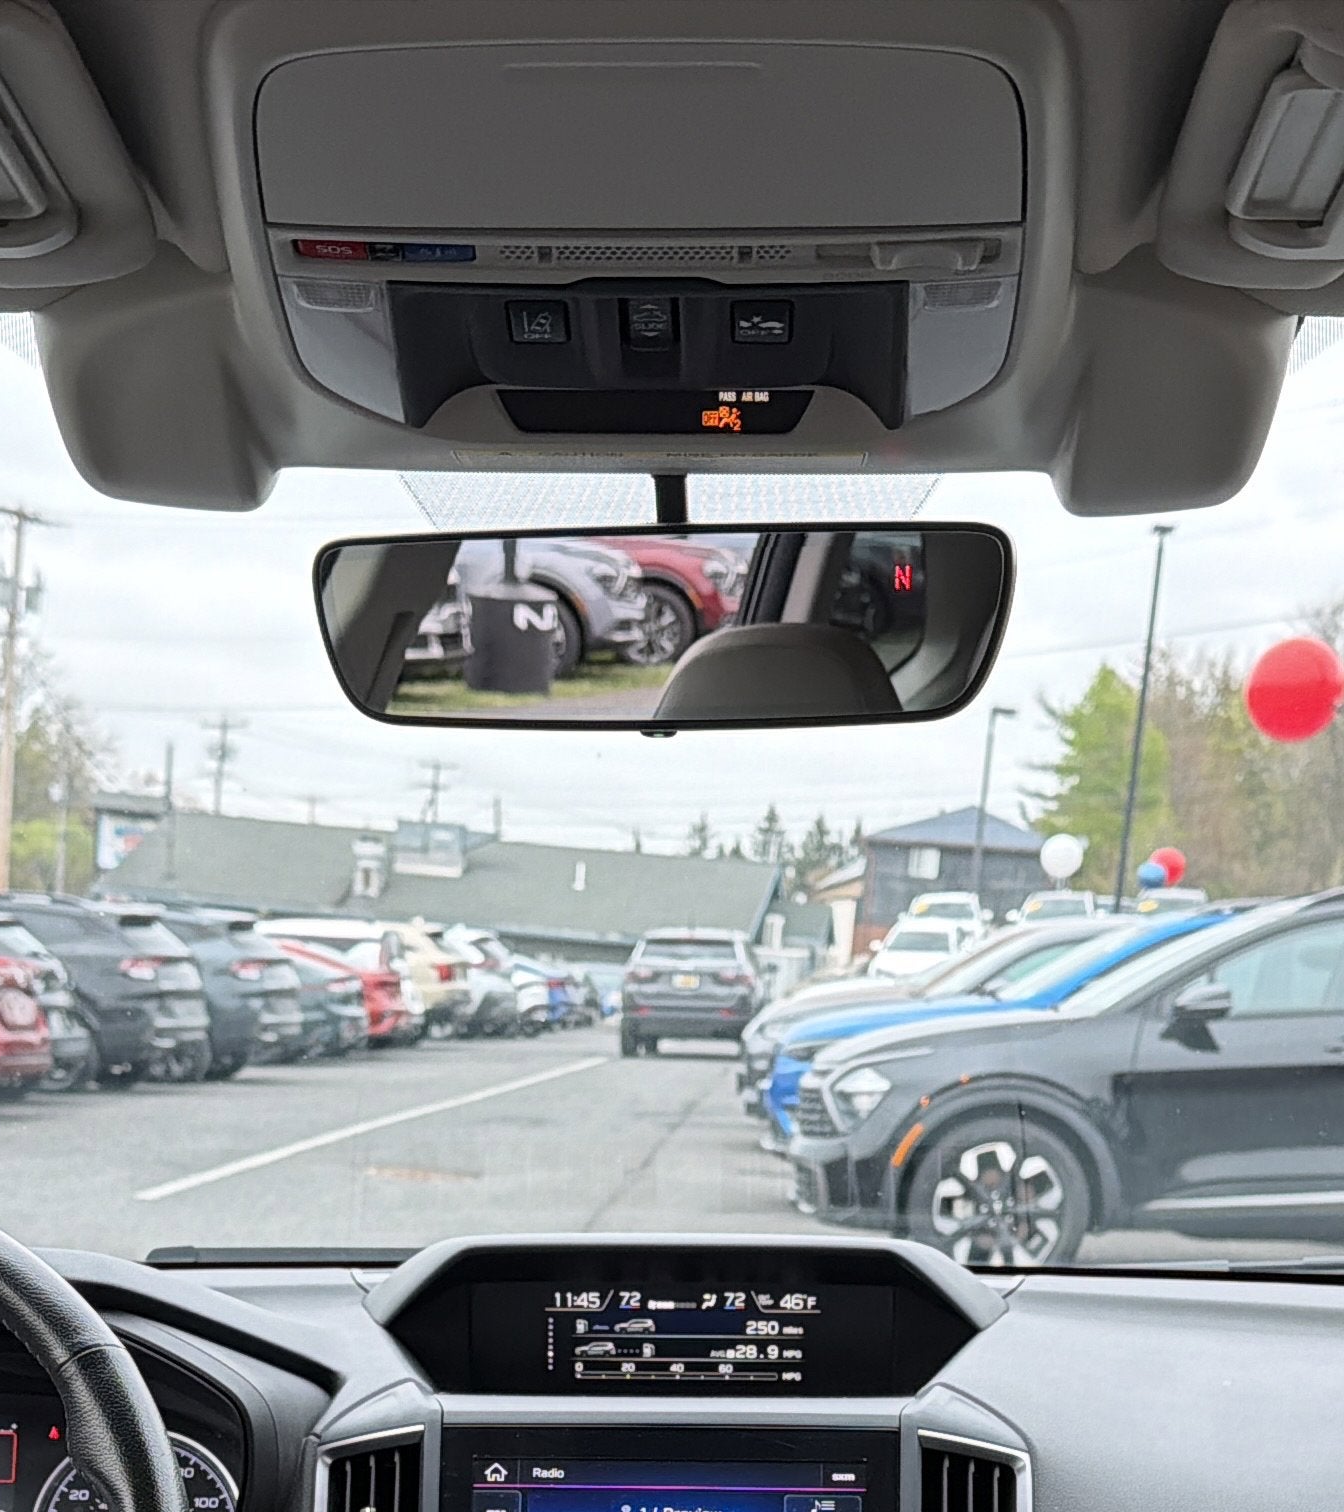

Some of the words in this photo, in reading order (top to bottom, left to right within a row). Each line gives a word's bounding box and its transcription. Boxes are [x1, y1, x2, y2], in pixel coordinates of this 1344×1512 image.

[315, 244, 353, 255] SOS
[718, 391, 737, 402] PASS
[740, 391, 754, 402] AIR
[754, 391, 770, 402] BAG
[894, 564, 913, 592] N
[554, 1291, 601, 1309] 11:45
[618, 1291, 642, 1307] 72
[723, 1292, 747, 1307] 72
[745, 1320, 780, 1335] 250
[735, 1344, 779, 1360] 28.9
[620, 1362, 636, 1373] 20
[669, 1363, 685, 1373] 40
[718, 1363, 734, 1374] 60
[532, 1467, 565, 1479] Radio
[68, 1489, 90, 1501] 20
[193, 1497, 219, 1509] 100
